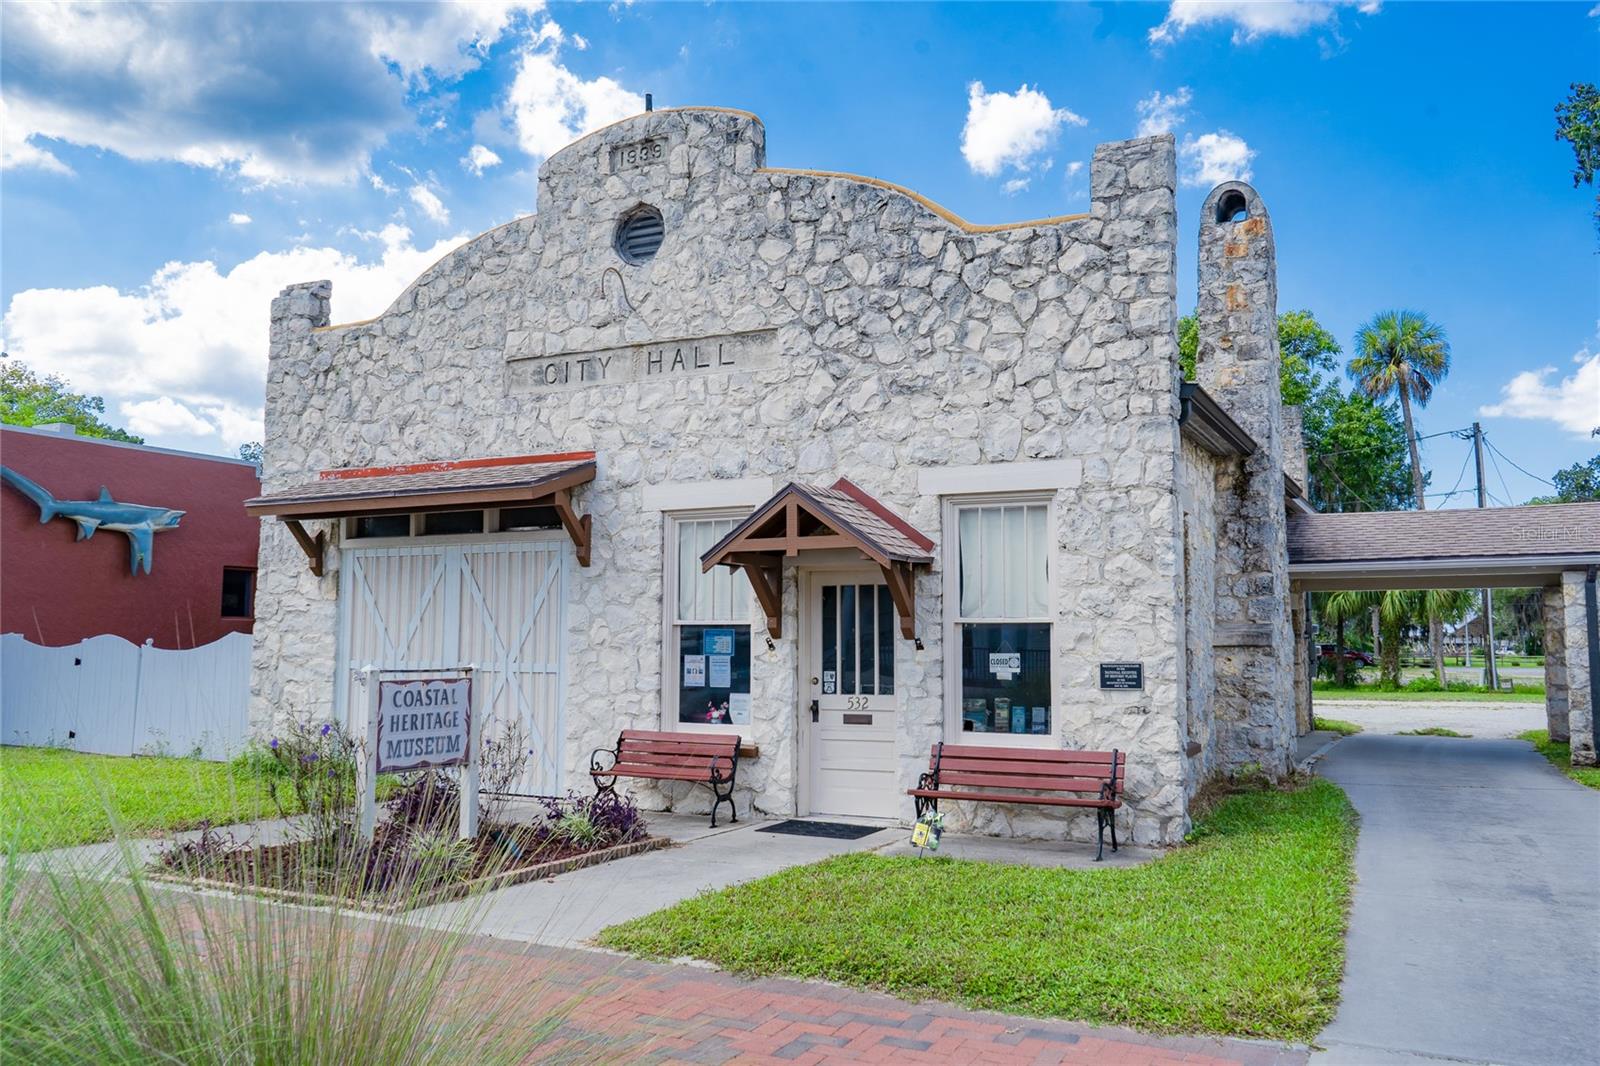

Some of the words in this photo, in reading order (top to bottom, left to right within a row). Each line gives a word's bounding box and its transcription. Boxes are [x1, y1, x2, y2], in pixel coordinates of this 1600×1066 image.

[620, 144, 662, 167] 1939
[544, 355, 612, 385] CITY
[647, 343, 736, 375] HALL
[990, 657, 1009, 666] CLOSED
[393, 688, 458, 708] COASTAL
[847, 696, 869, 711] 532
[390, 711, 459, 732] HERITAGE
[386, 734, 460, 759] MUSEUM
